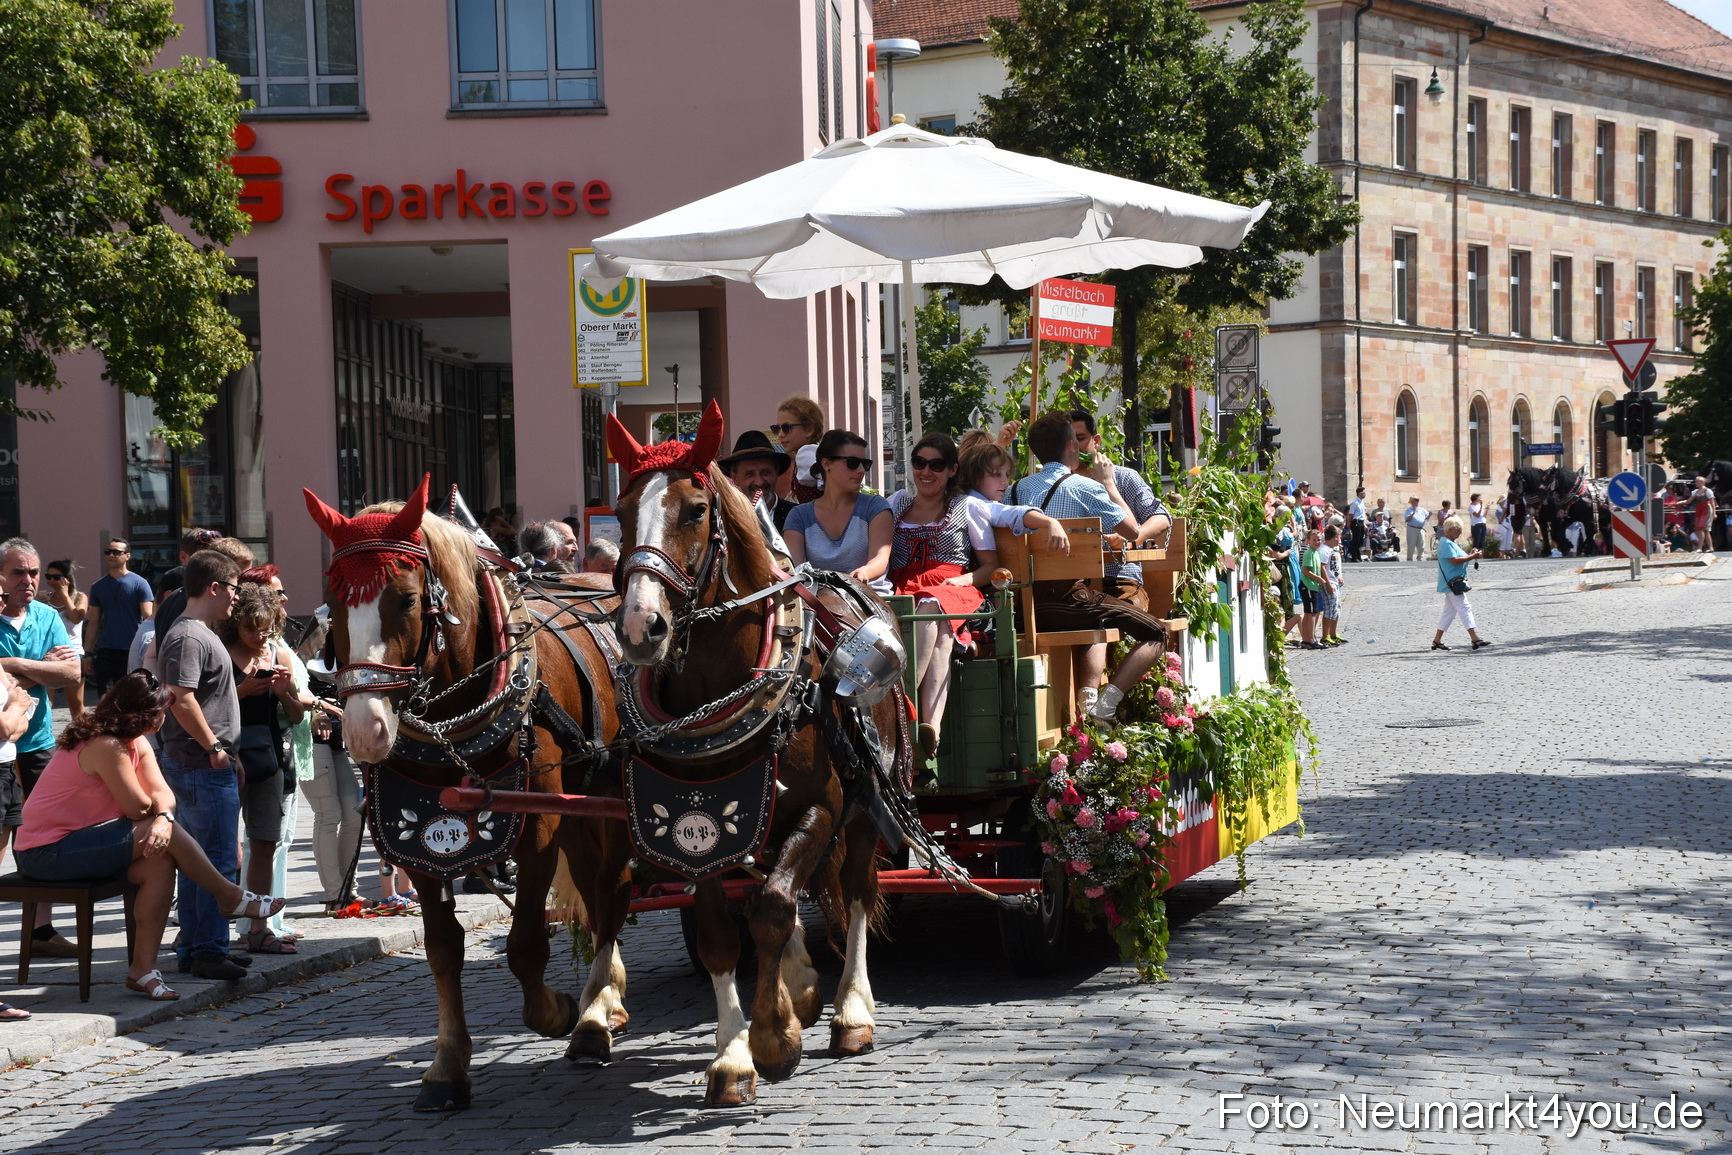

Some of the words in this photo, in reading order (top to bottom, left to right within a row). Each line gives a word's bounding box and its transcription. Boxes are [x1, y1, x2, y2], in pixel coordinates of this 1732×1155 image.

[325, 169, 611, 233] Sparkasse
[1040, 281, 1105, 303] Mistelbach
[1051, 303, 1088, 320] grüßt
[580, 323, 610, 332] Oberer
[613, 321, 637, 331] Markt
[1040, 321, 1101, 340] Neumarkt
[1228, 358, 1247, 366] ZONE
[1228, 400, 1247, 408] ZONE
